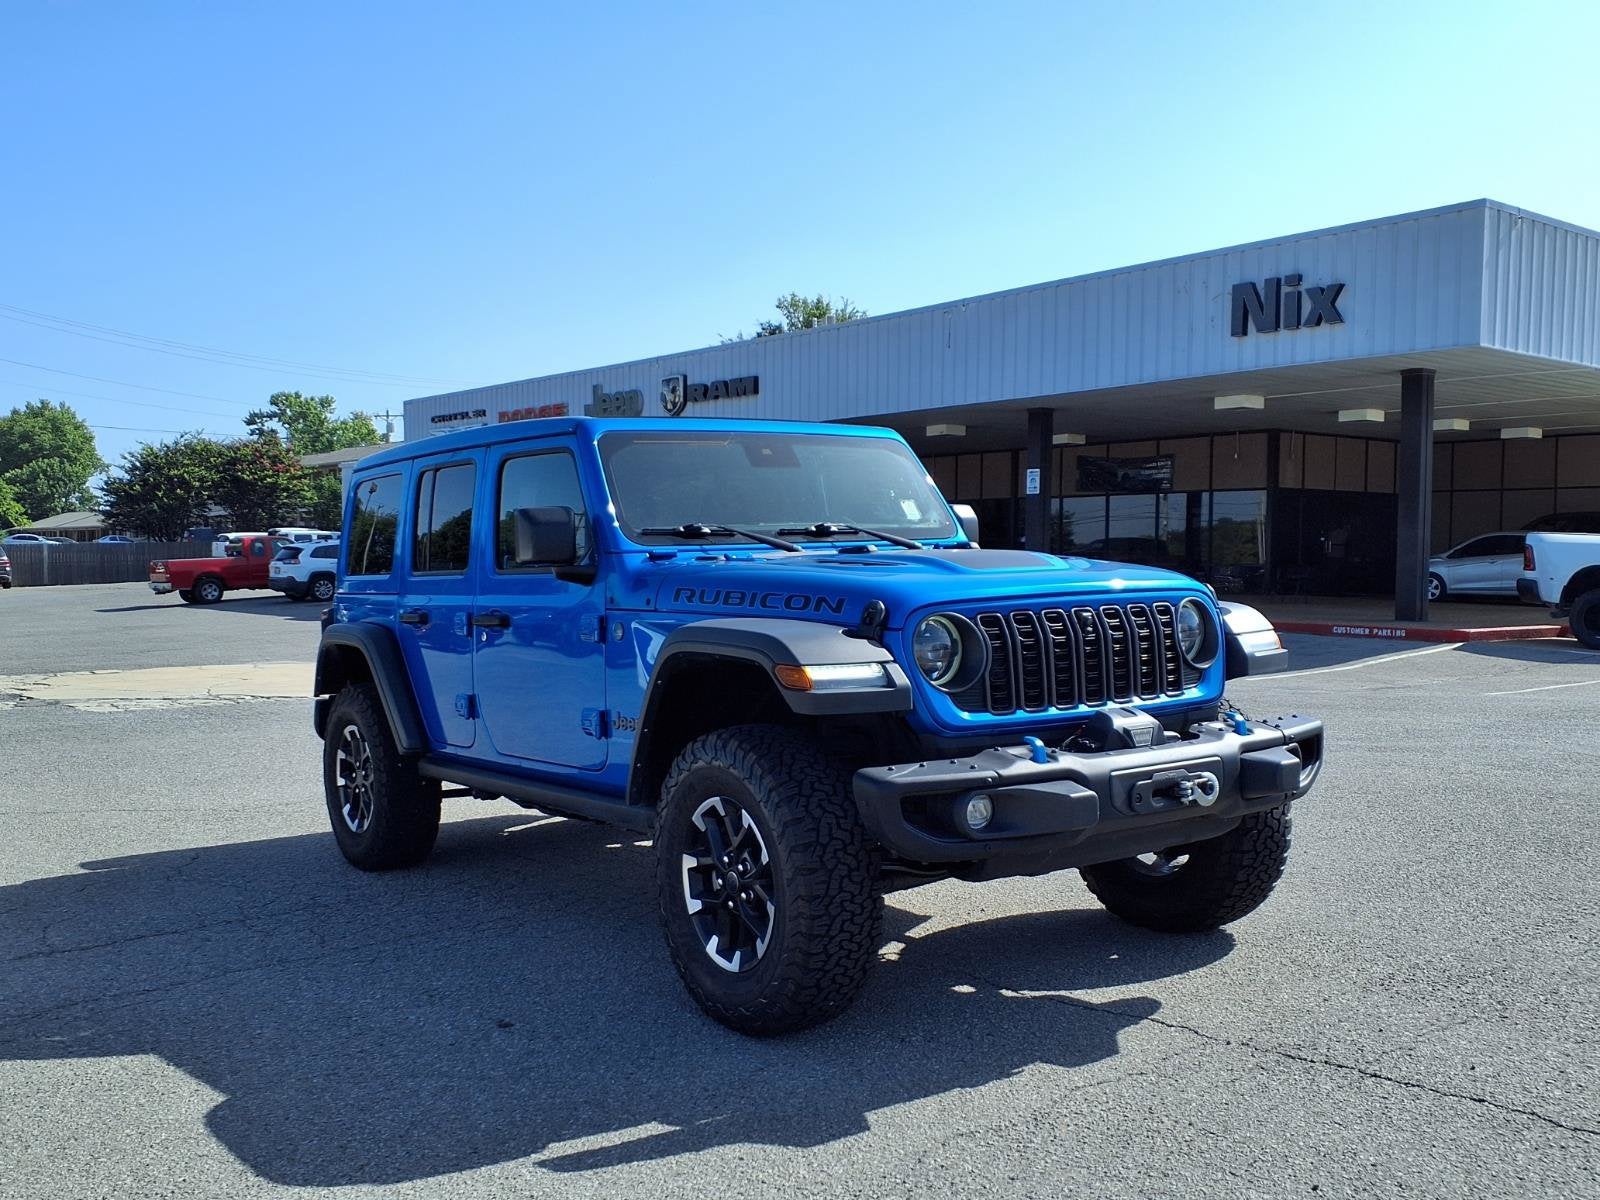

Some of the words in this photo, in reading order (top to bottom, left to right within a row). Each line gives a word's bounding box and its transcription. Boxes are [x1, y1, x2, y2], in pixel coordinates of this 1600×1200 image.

[1231, 273, 1345, 337] Nix
[584, 384, 644, 417] Jeep
[687, 376, 759, 402] RAM
[498, 403, 569, 423] DODGE
[672, 587, 848, 616] RUBICON
[1333, 626, 1370, 635] CUSTOMER
[1373, 628, 1406, 637] PARKING
